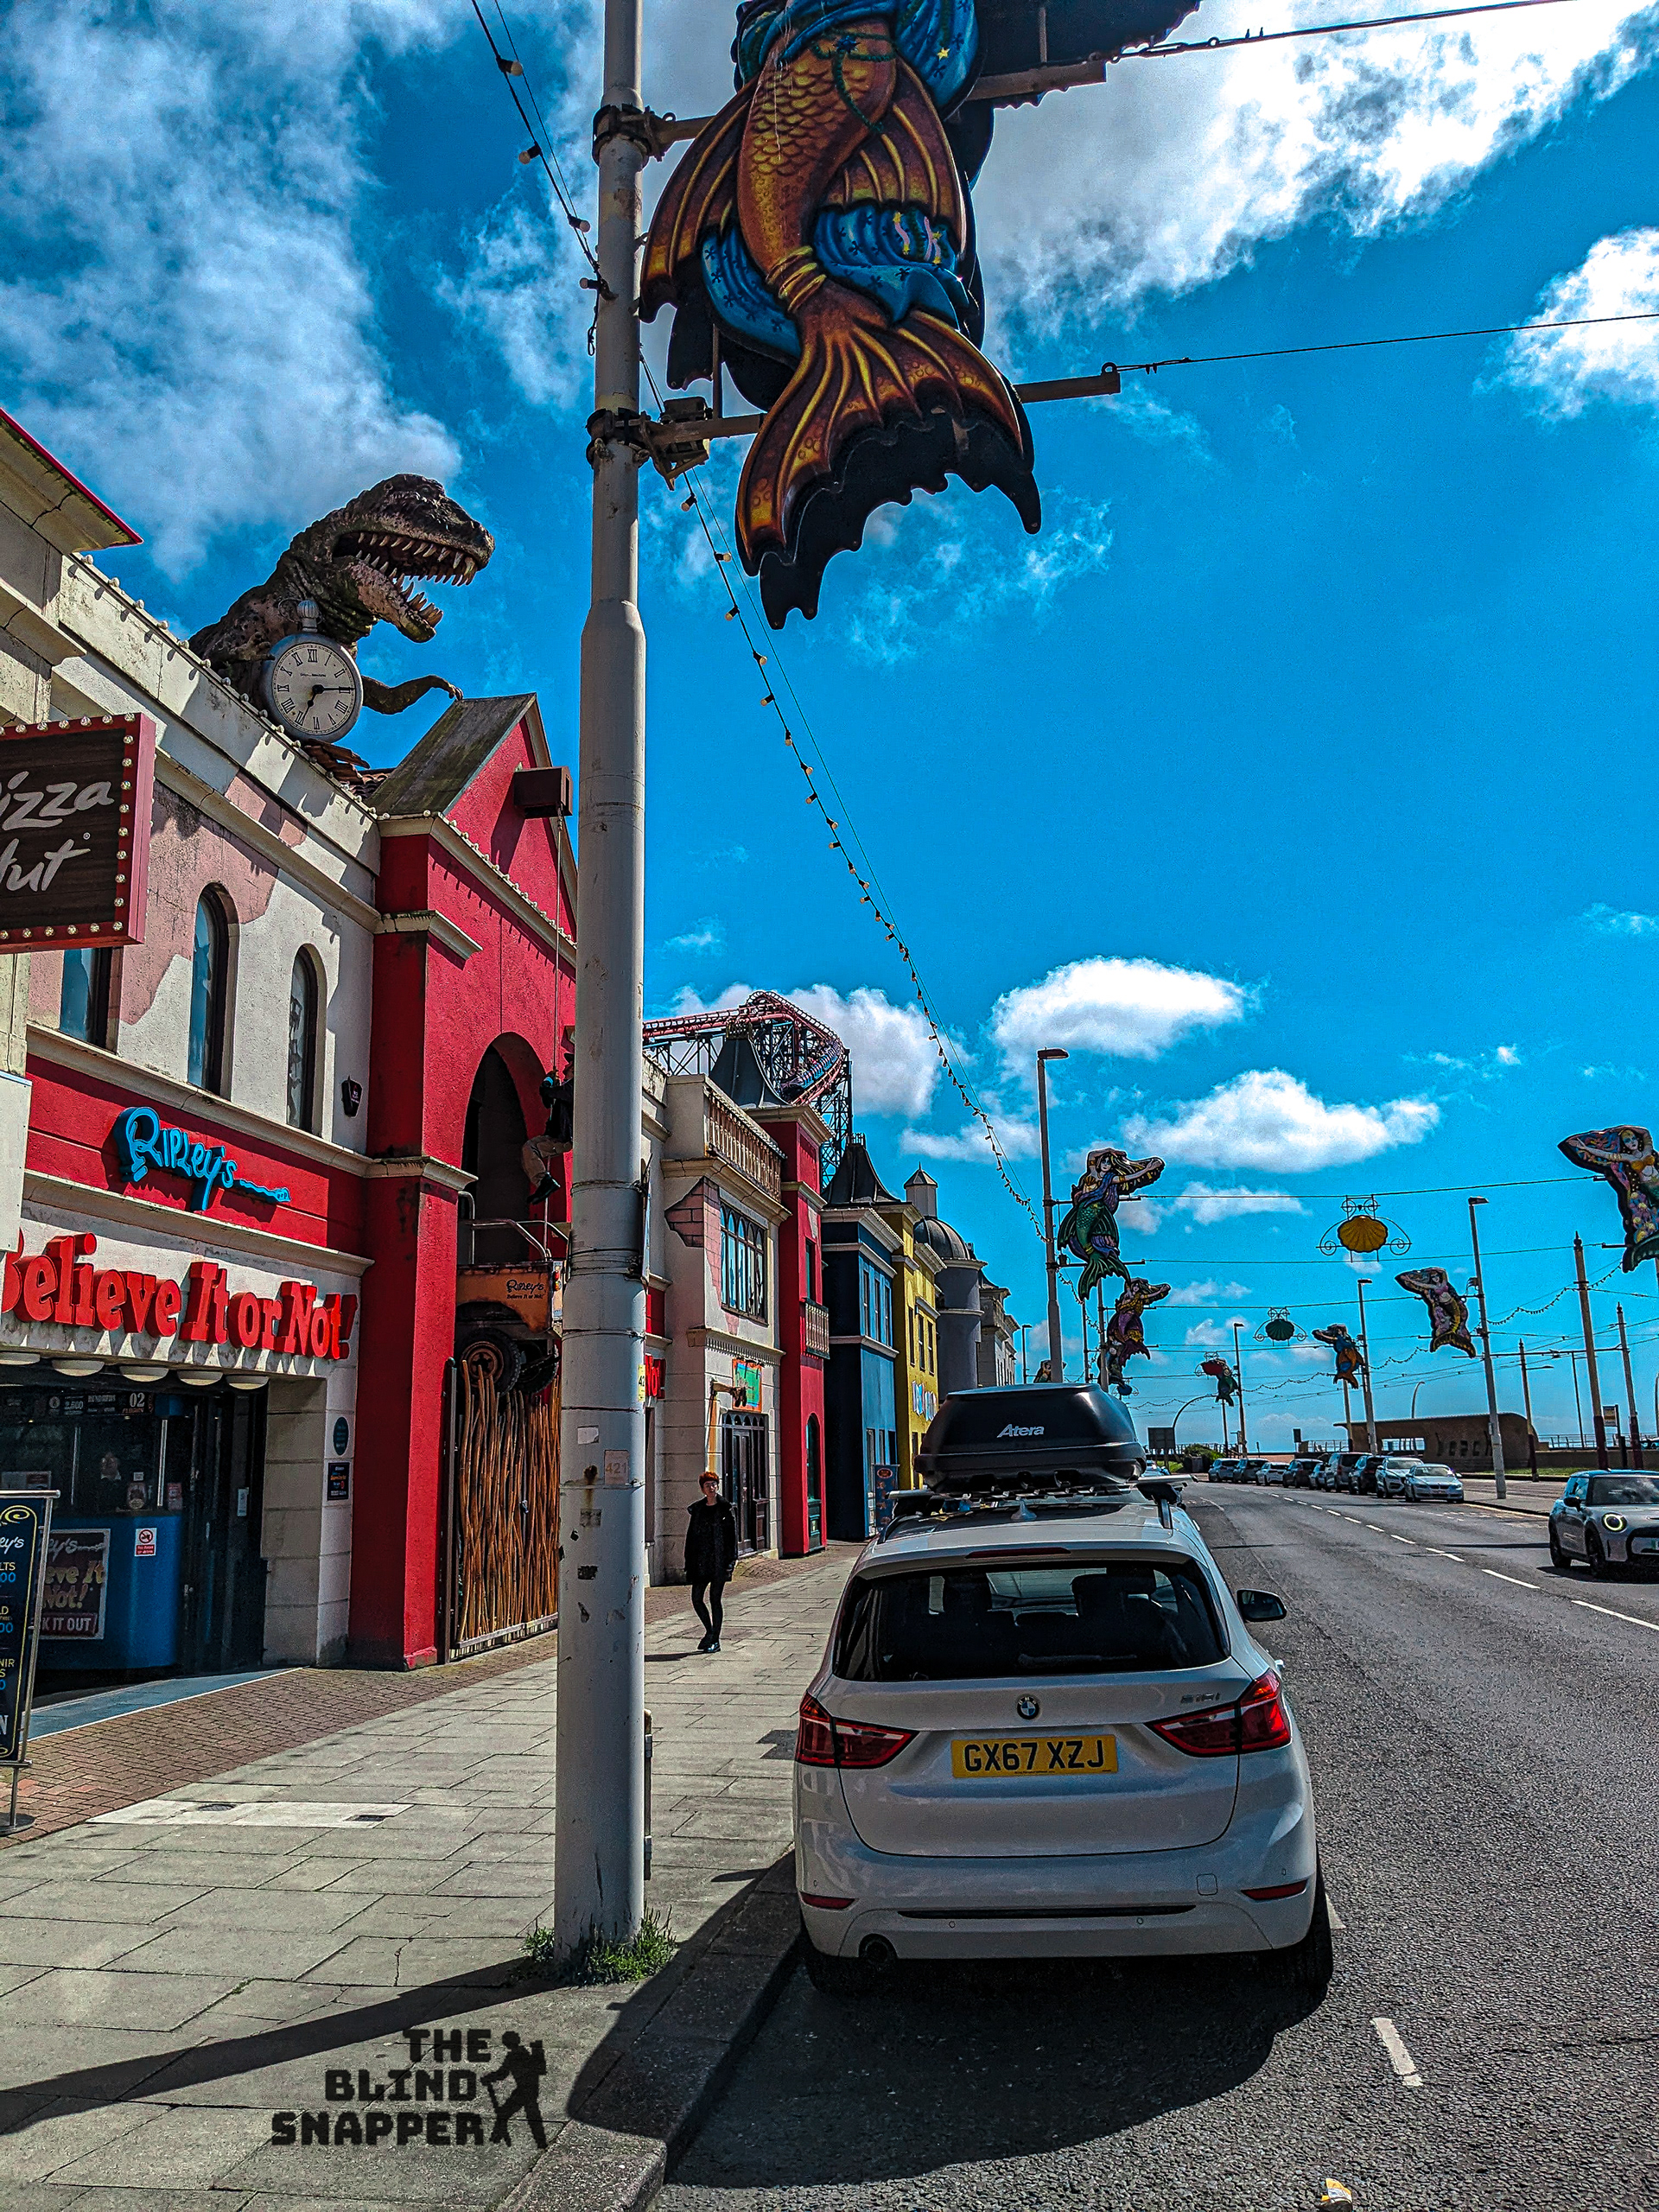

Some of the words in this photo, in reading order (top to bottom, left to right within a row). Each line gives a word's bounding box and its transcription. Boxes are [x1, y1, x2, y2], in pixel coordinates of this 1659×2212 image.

[0, 771, 115, 830] izza
[114, 1107, 240, 1211] Ripley's
[180, 1262, 229, 1344] It
[229, 1292, 283, 1350] or
[274, 1281, 358, 1359] Not!
[996, 1424, 1045, 1439] Atera
[605, 1461, 627, 1474] 421
[964, 1742, 1038, 1772] GX67
[1046, 1739, 1104, 1770] XZJ
